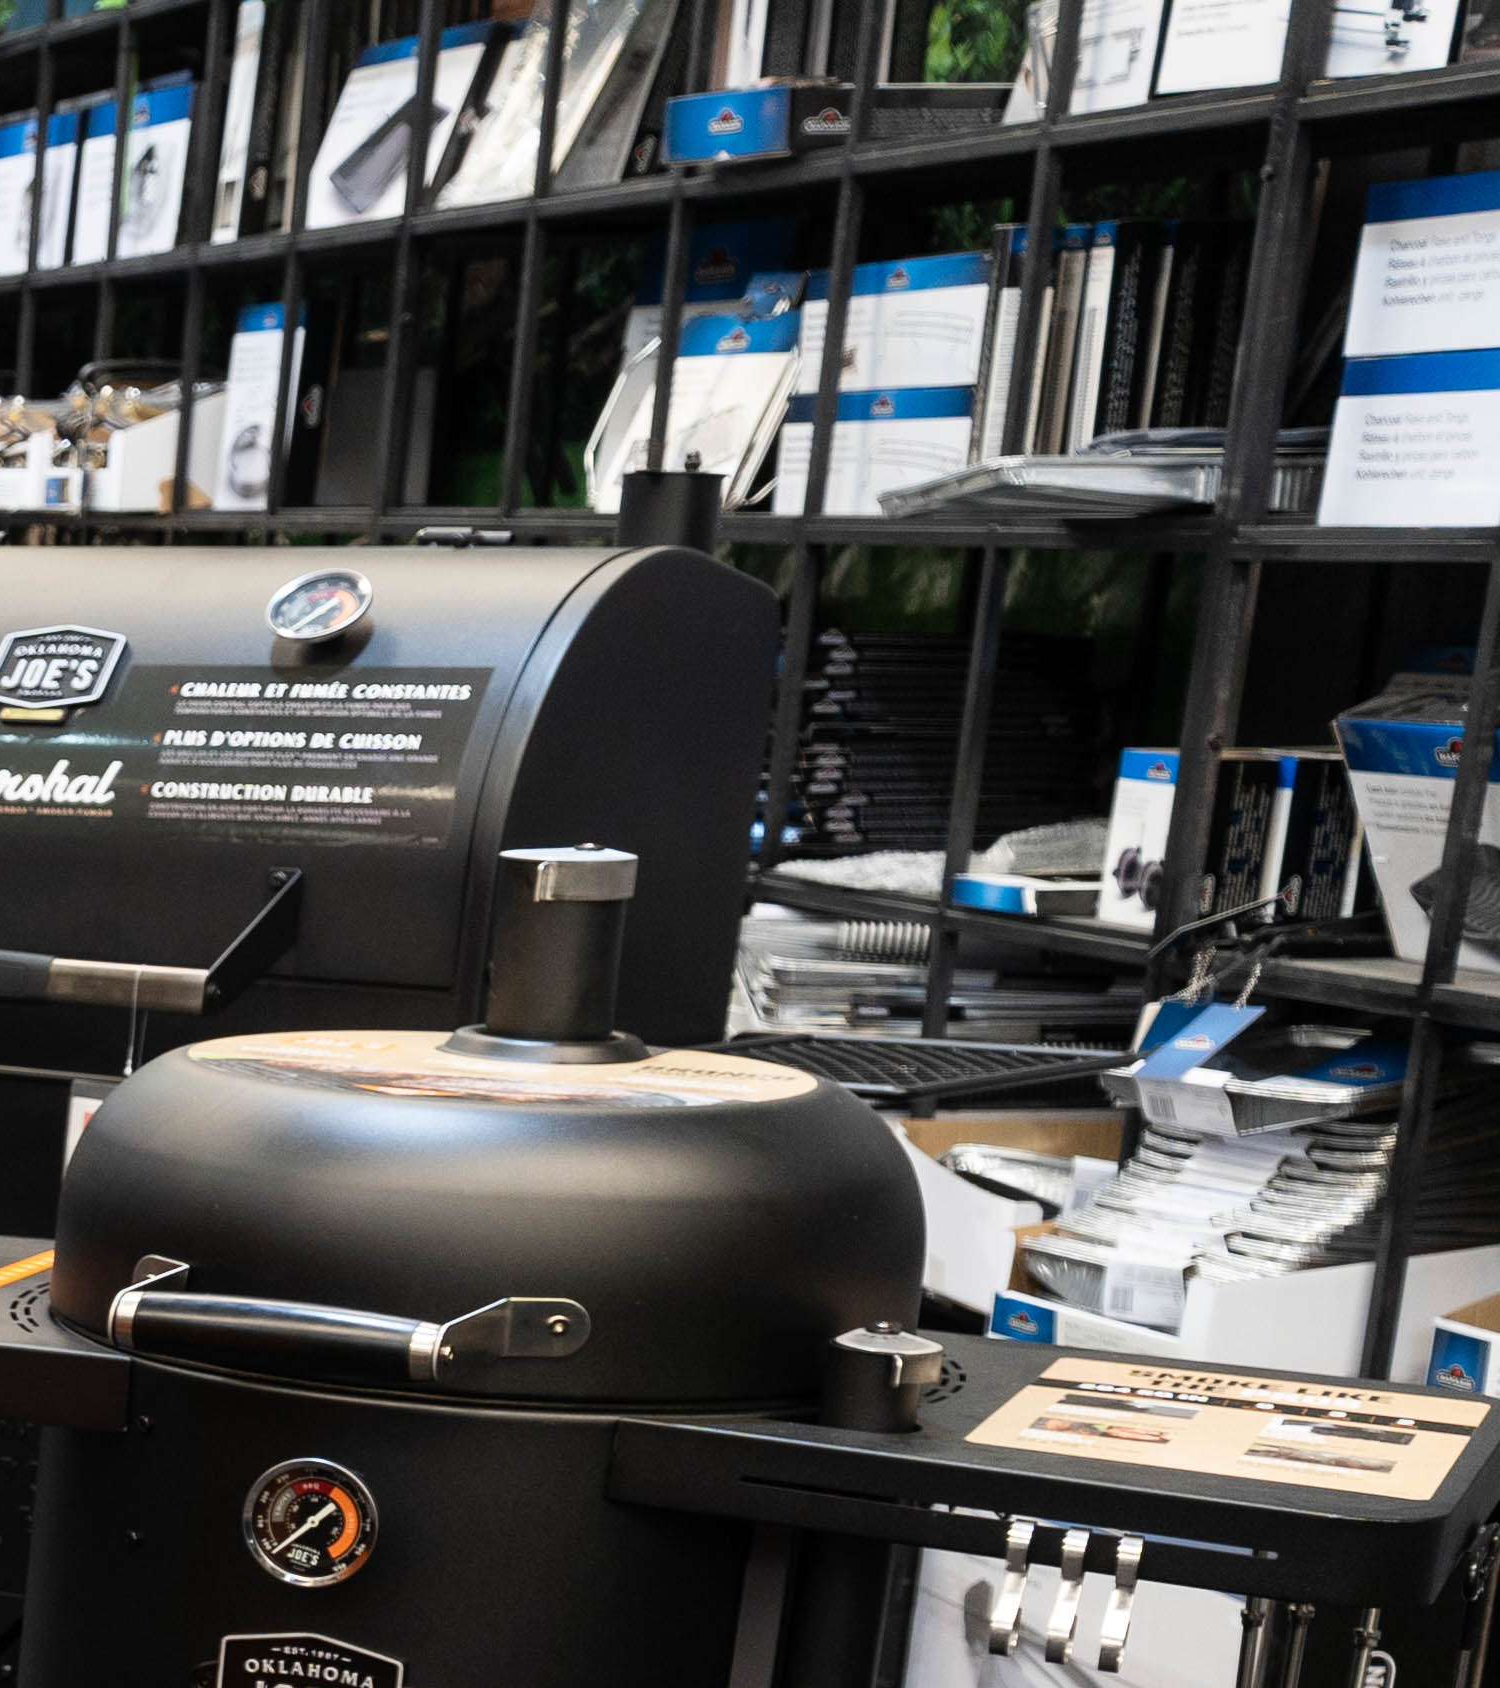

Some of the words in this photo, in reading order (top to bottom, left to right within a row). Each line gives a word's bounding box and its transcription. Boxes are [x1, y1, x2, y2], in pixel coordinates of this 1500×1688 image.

[14, 643, 103, 658] OKLAHOMA
[0, 658, 99, 691] JOE'S
[180, 681, 261, 699] CHALEUR
[264, 682, 289, 699] ET
[290, 680, 349, 700] FUMÉE
[352, 683, 473, 701] CONSTANTES
[162, 729, 207, 747] PLUS
[209, 730, 308, 749] D'OPTIONS
[309, 732, 336, 749] DE
[338, 733, 422, 751] CUISSON
[150, 781, 288, 802] CONSTRUCTION
[290, 785, 374, 804] DURABLE
[1129, 1368, 1285, 1391] SMOKE
[1297, 1387, 1393, 1404] LIKE
